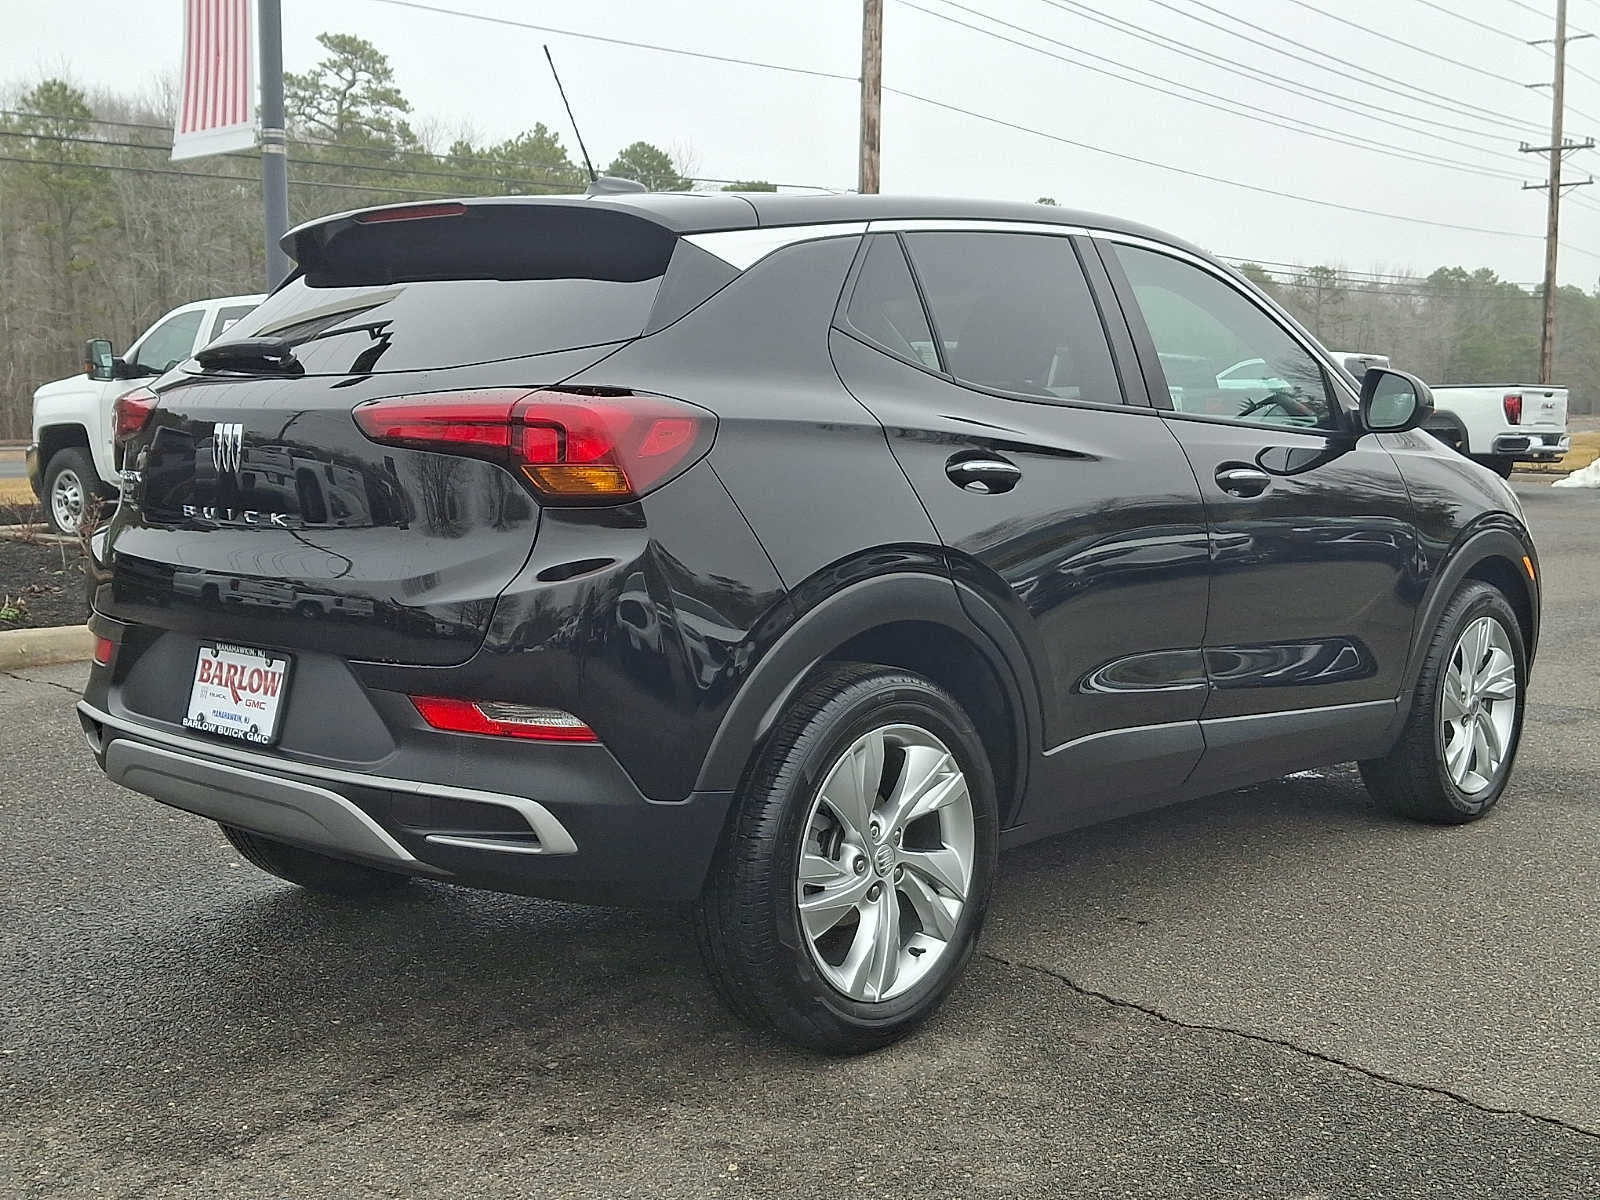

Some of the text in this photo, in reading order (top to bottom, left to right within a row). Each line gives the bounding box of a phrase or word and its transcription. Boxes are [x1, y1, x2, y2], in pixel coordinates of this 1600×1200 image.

[183, 505, 288, 527] BUICK
[198, 658, 284, 704] BARLOW
[245, 699, 267, 710] GMC
[182, 718, 269, 744] BARLOW BUICK GMC
